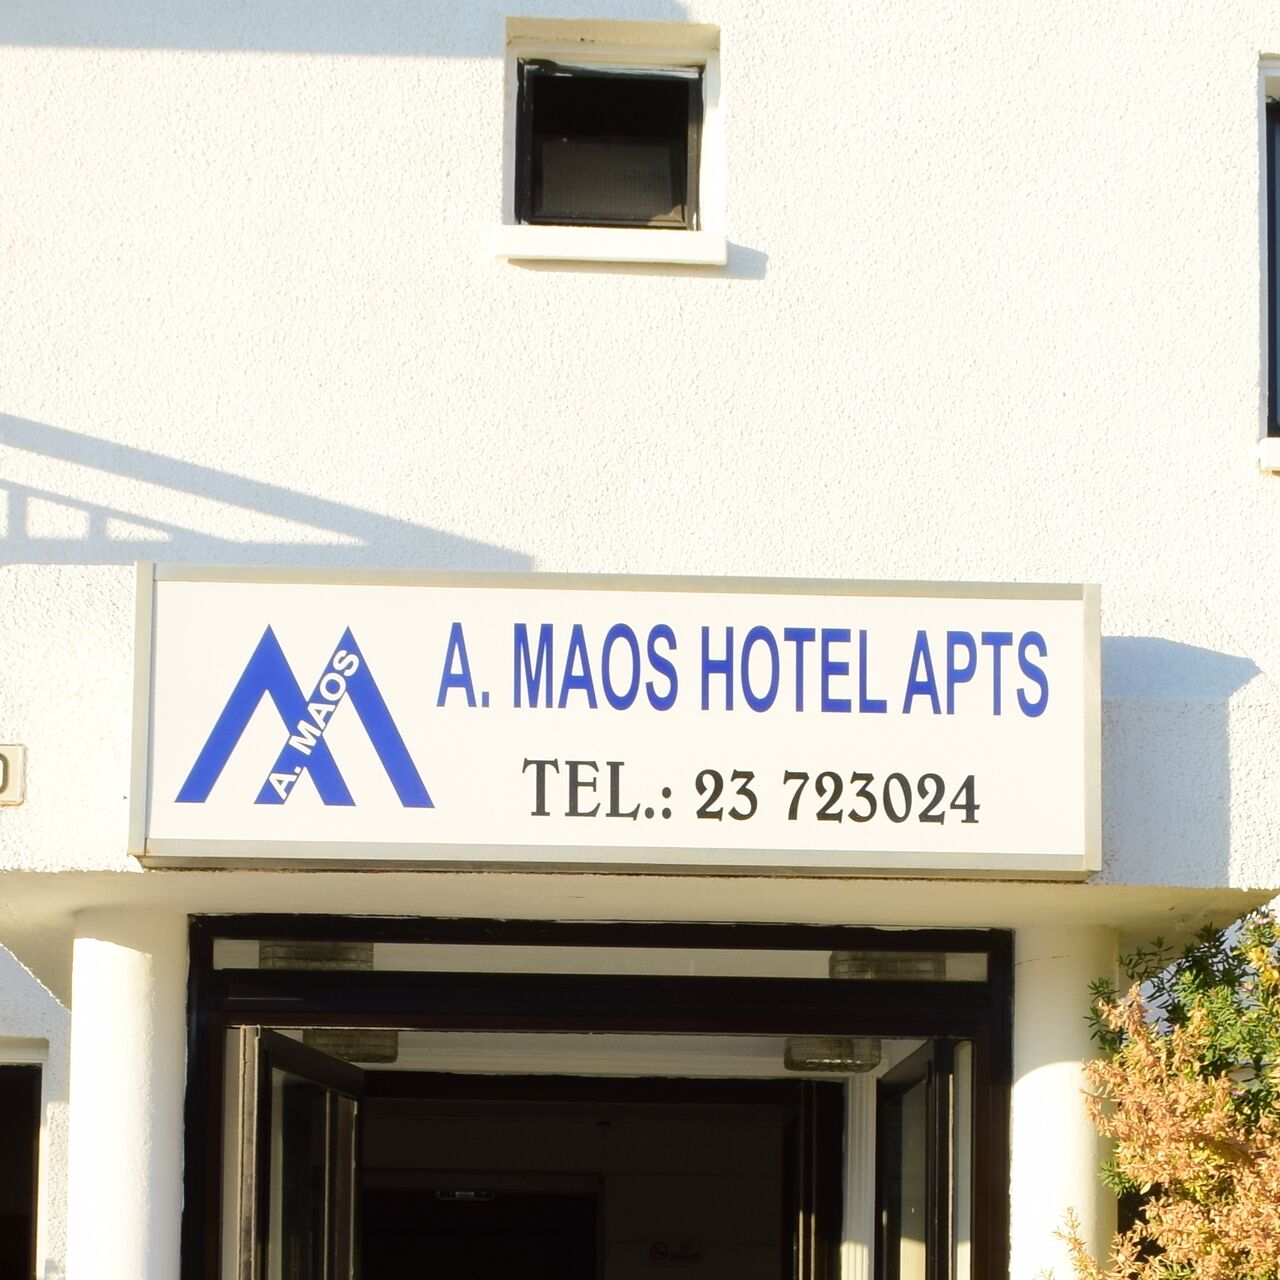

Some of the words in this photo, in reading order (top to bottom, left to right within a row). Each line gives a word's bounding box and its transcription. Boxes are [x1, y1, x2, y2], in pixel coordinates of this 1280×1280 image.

[436, 622, 490, 708] A.
[513, 622, 679, 712] MAOS
[701, 625, 888, 714] HOTEL
[902, 629, 1049, 718] APTS
[268, 766, 302, 801] A.
[288, 649, 360, 756] MAOS
[522, 757, 672, 821] TEL.:
[694, 768, 758, 822] 23
[783, 769, 981, 826] 723024
